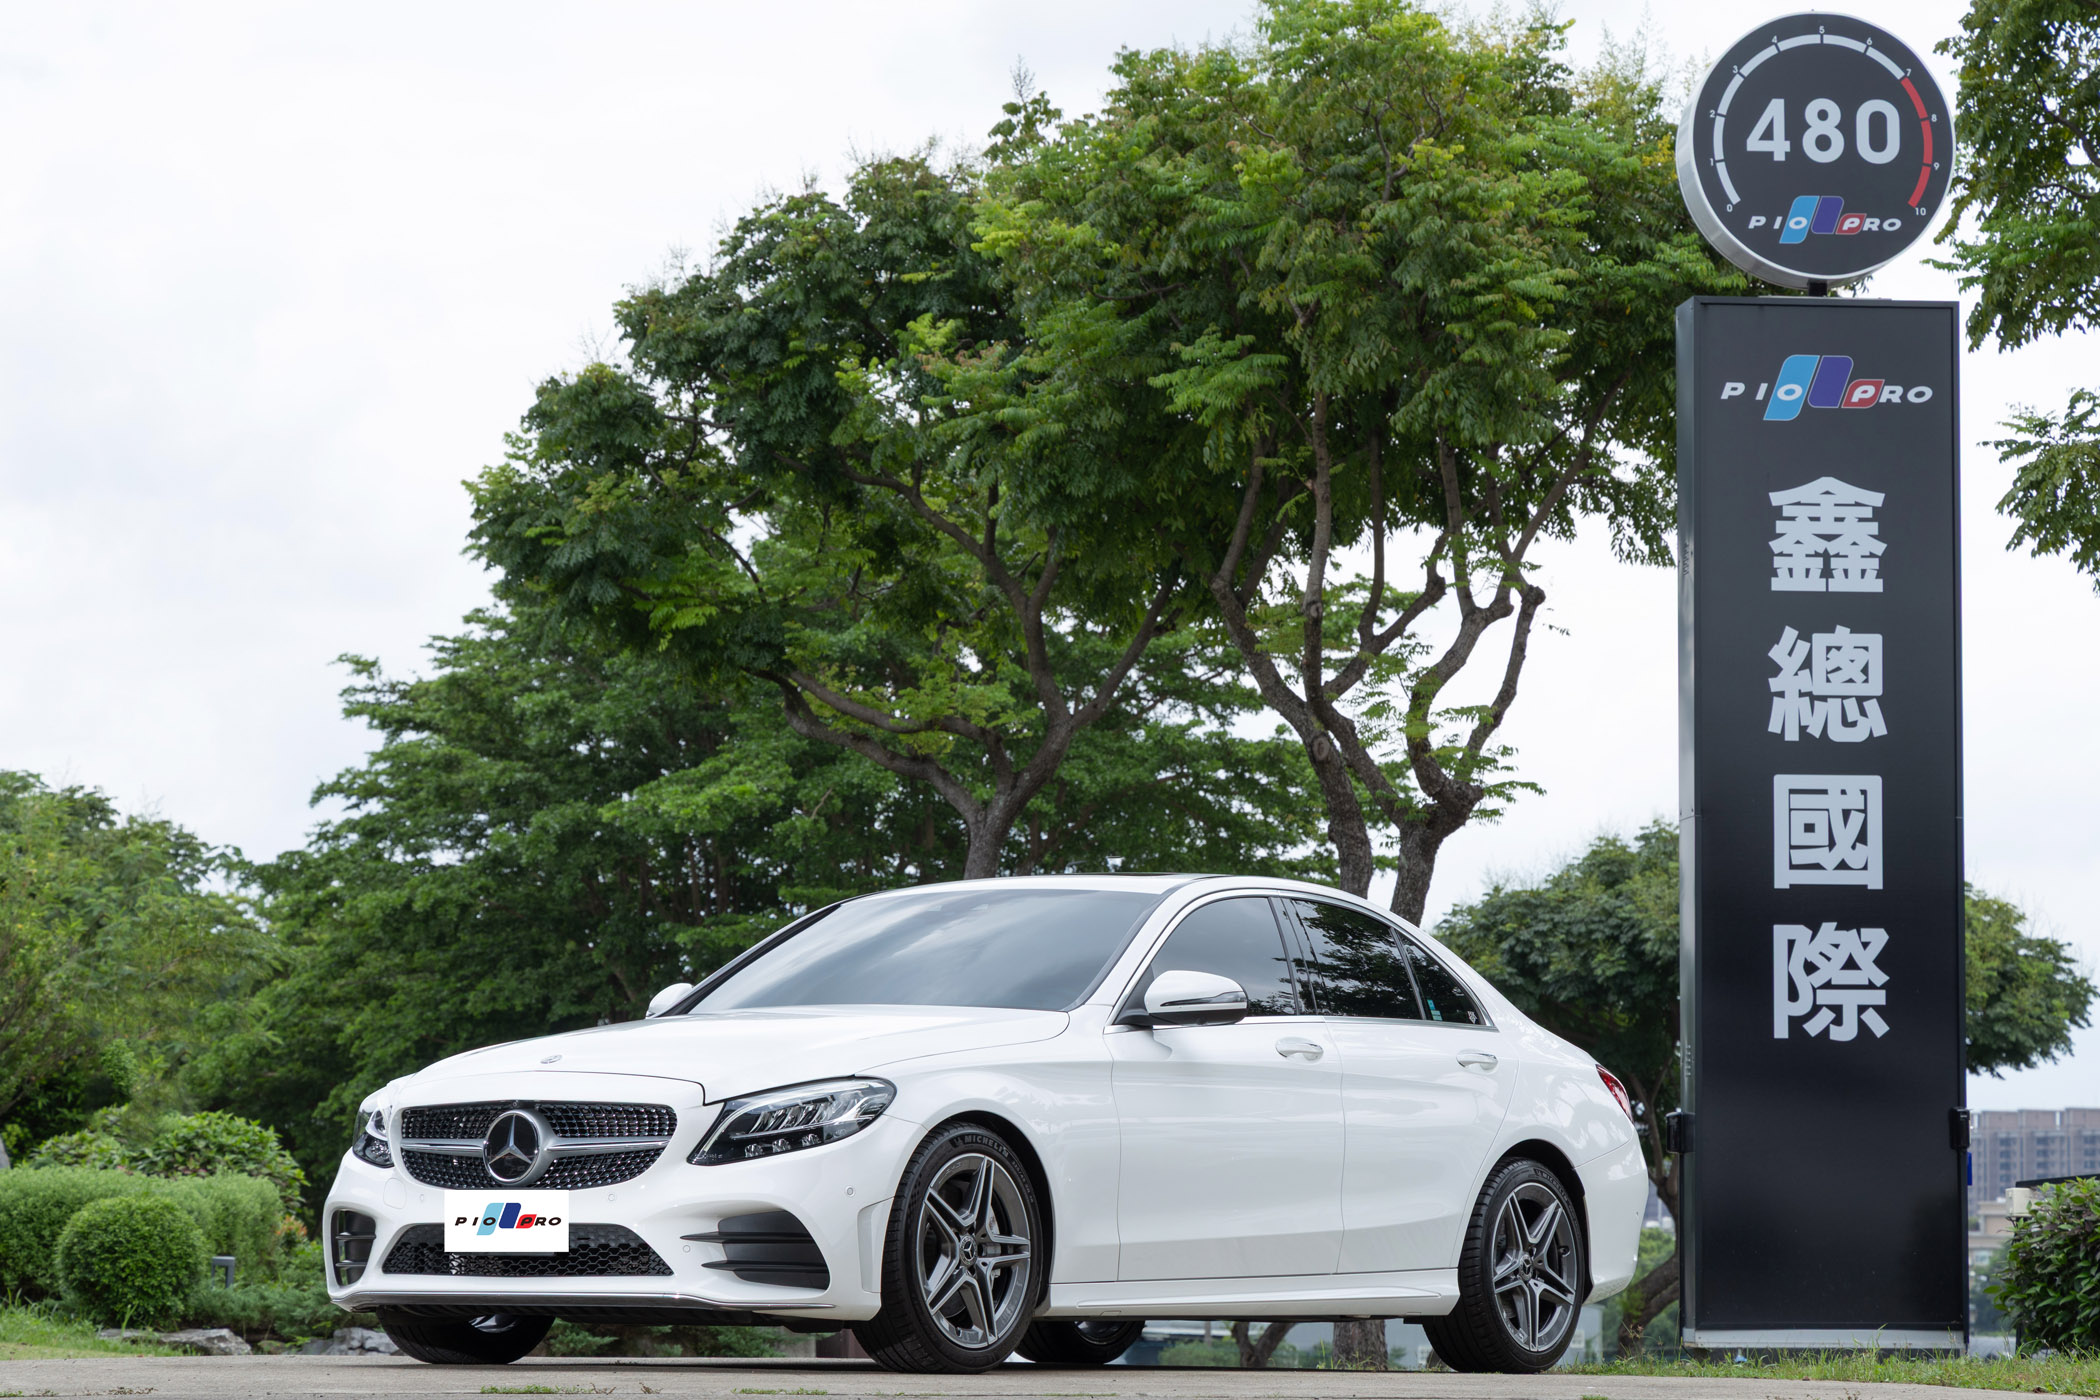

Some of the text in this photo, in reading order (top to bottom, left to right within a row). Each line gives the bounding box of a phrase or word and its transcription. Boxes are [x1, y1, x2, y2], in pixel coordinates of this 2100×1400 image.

[1819, 26, 1825, 34] 5
[1771, 35, 1778, 44] 4
[1866, 37, 1873, 46] 6
[1732, 65, 1739, 74] 3
[1906, 69, 1912, 77] 7
[1709, 110, 1716, 118] 2
[1931, 114, 1938, 122] 8
[1746, 98, 1901, 165] 480
[1709, 158, 1714, 166] 1
[1933, 162, 1940, 171] 9
[1726, 204, 1733, 212] 0
[1915, 207, 1926, 216] 10
[1842, 217, 1902, 231] PRO
[1851, 384, 1933, 403] PRO
[1768, 476, 1890, 1042] 鑫總國際
[964, 1134, 1009, 1158] MICHELIN
